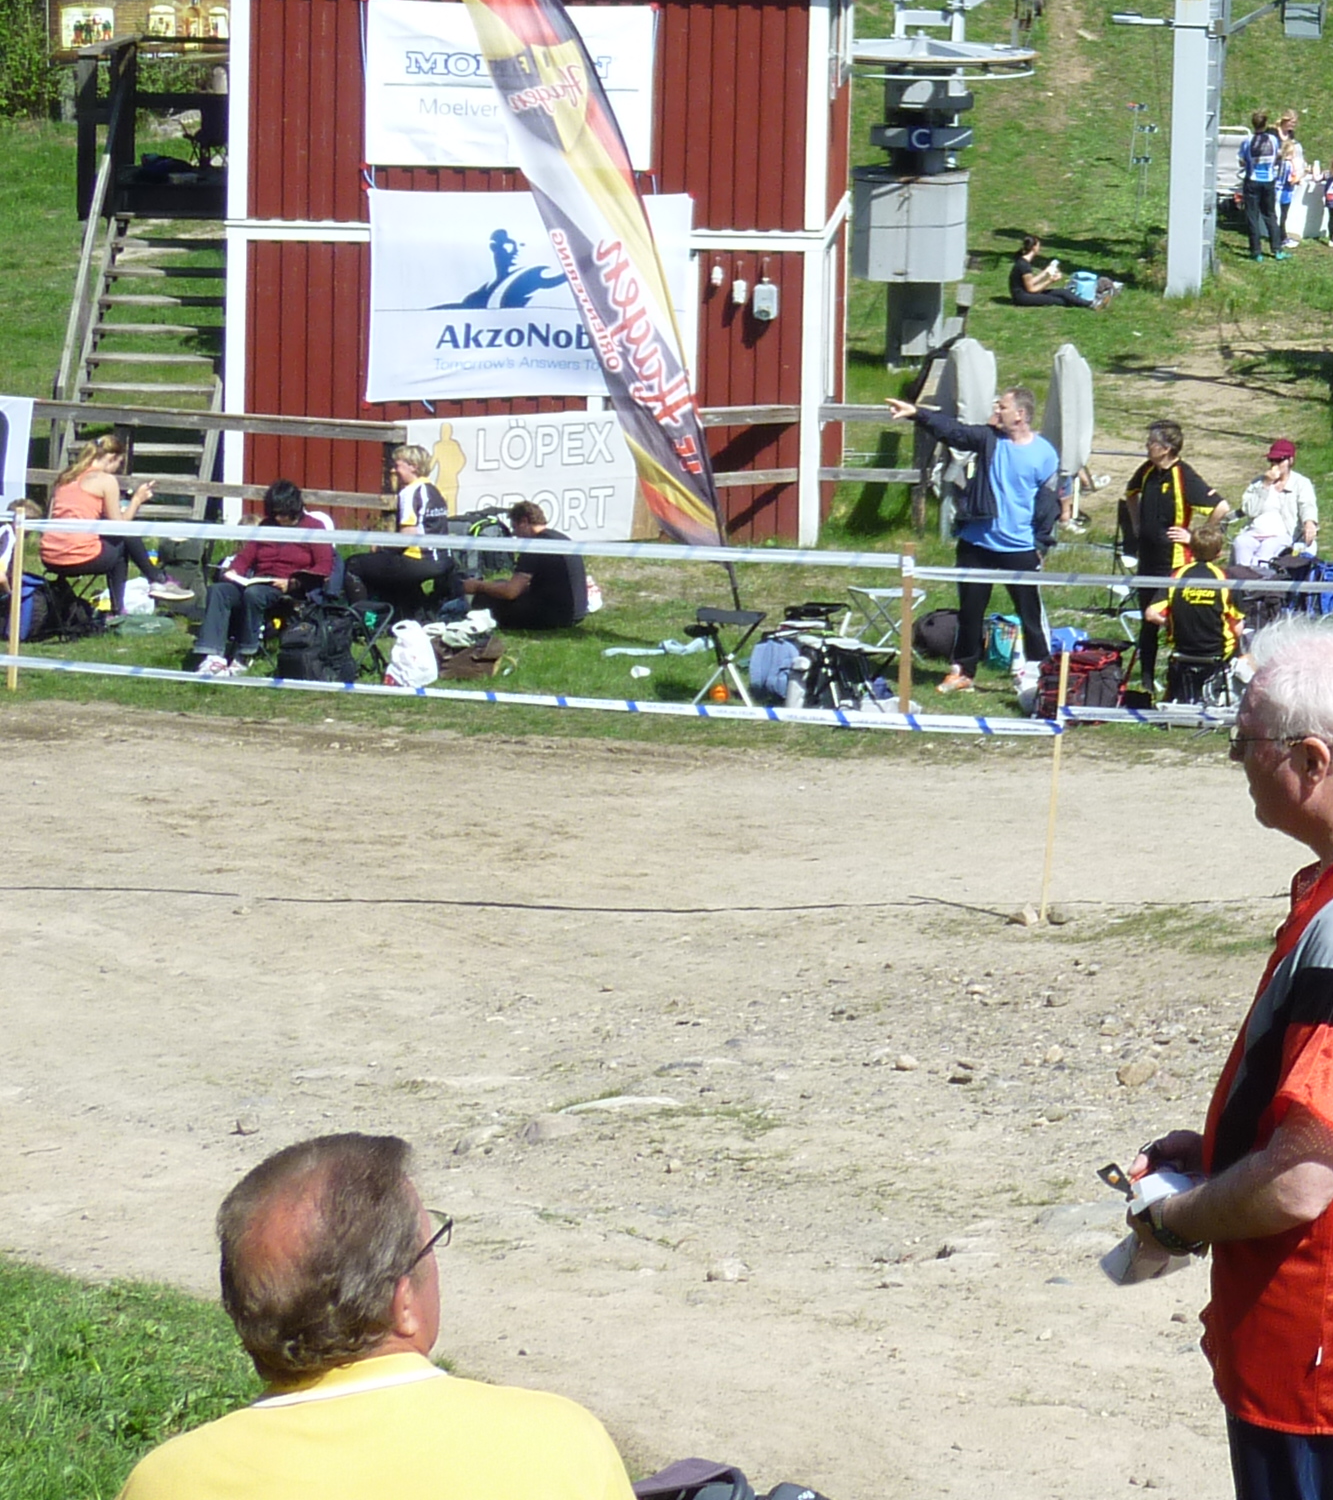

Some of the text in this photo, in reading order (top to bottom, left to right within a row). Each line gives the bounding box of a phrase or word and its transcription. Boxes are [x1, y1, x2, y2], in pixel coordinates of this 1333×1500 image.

[911, 128, 931, 149] C
[436, 323, 593, 350] AkzoNob
[433, 357, 515, 372] Tomorrow's
[518, 355, 581, 371] Answers
[475, 418, 615, 472] LÖPEX
